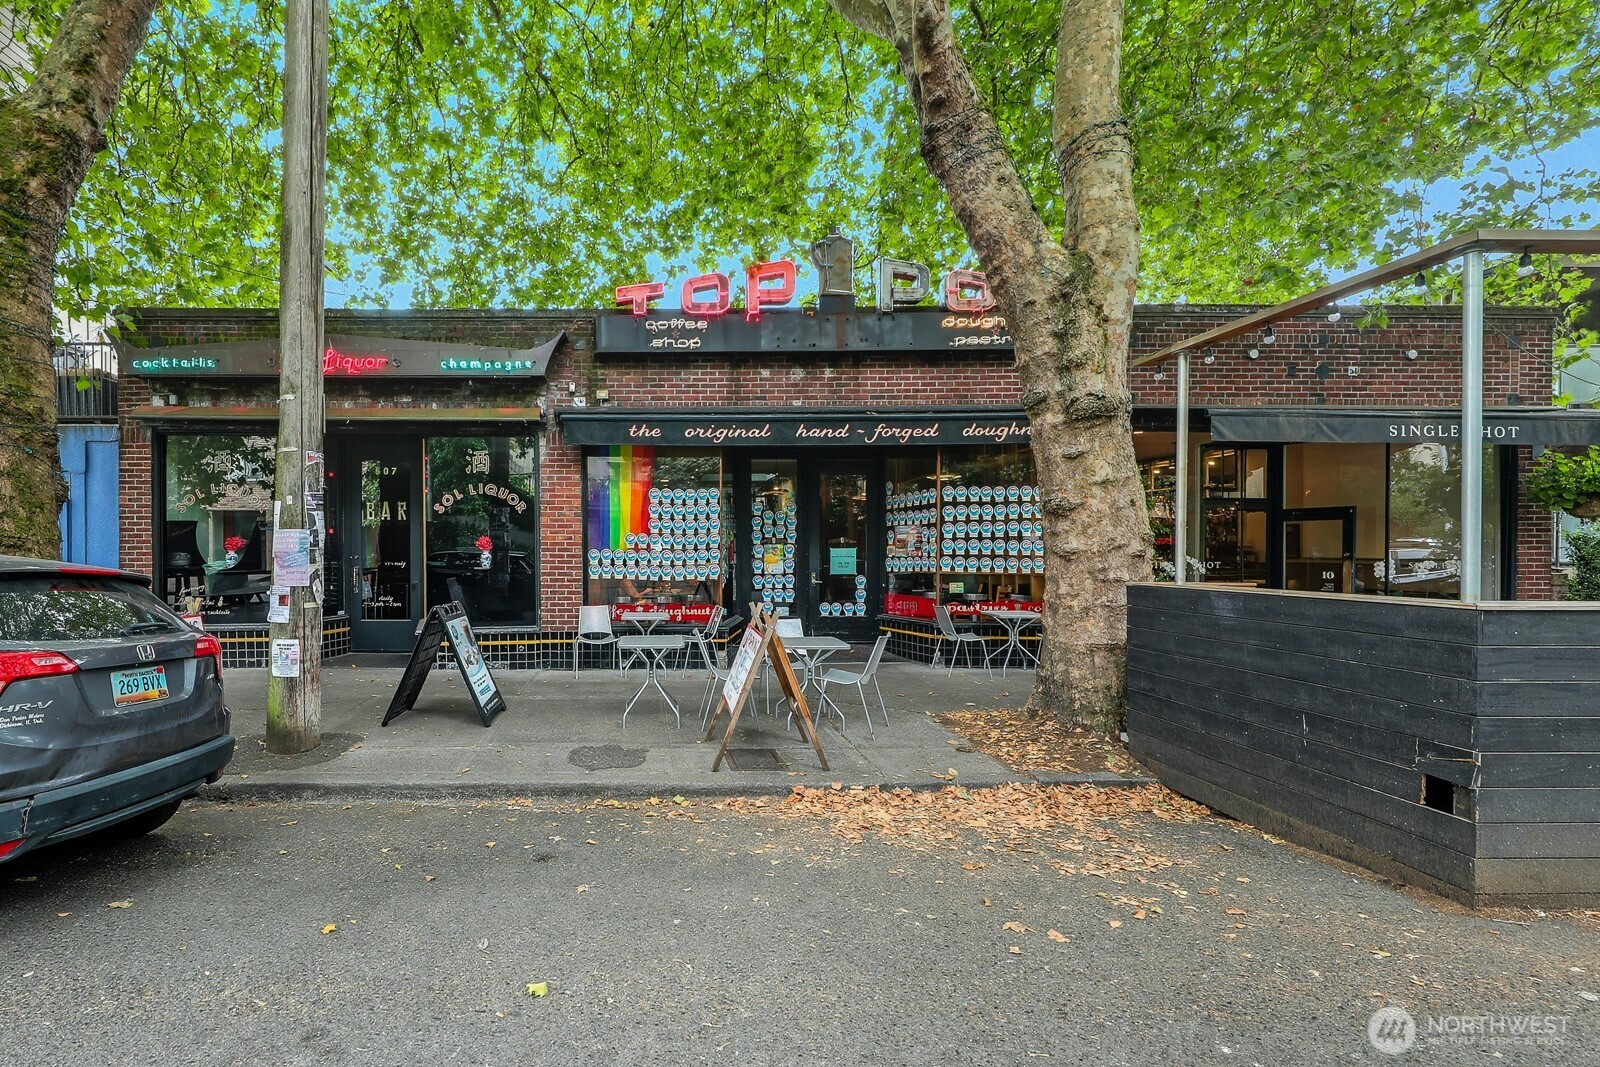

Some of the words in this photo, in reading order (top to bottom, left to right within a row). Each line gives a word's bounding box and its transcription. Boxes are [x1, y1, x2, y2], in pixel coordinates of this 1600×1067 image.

[615, 259, 797, 320] TOP
[877, 256, 996, 314] PO
[649, 336, 701, 350] shop
[949, 333, 1012, 348] pastr
[322, 348, 388, 375] Liquor
[440, 358, 532, 371] champagne
[629, 423, 662, 438] the
[684, 424, 771, 443] original
[962, 421, 1032, 442] doughn
[1389, 424, 1459, 438] SINGLE
[1481, 425, 1520, 438] HOT
[433, 488, 464, 514] SOL
[468, 483, 527, 514] LIQUOR
[366, 501, 408, 521] BAR
[118, 677, 140, 696] 269
[141, 674, 163, 692] BVX
